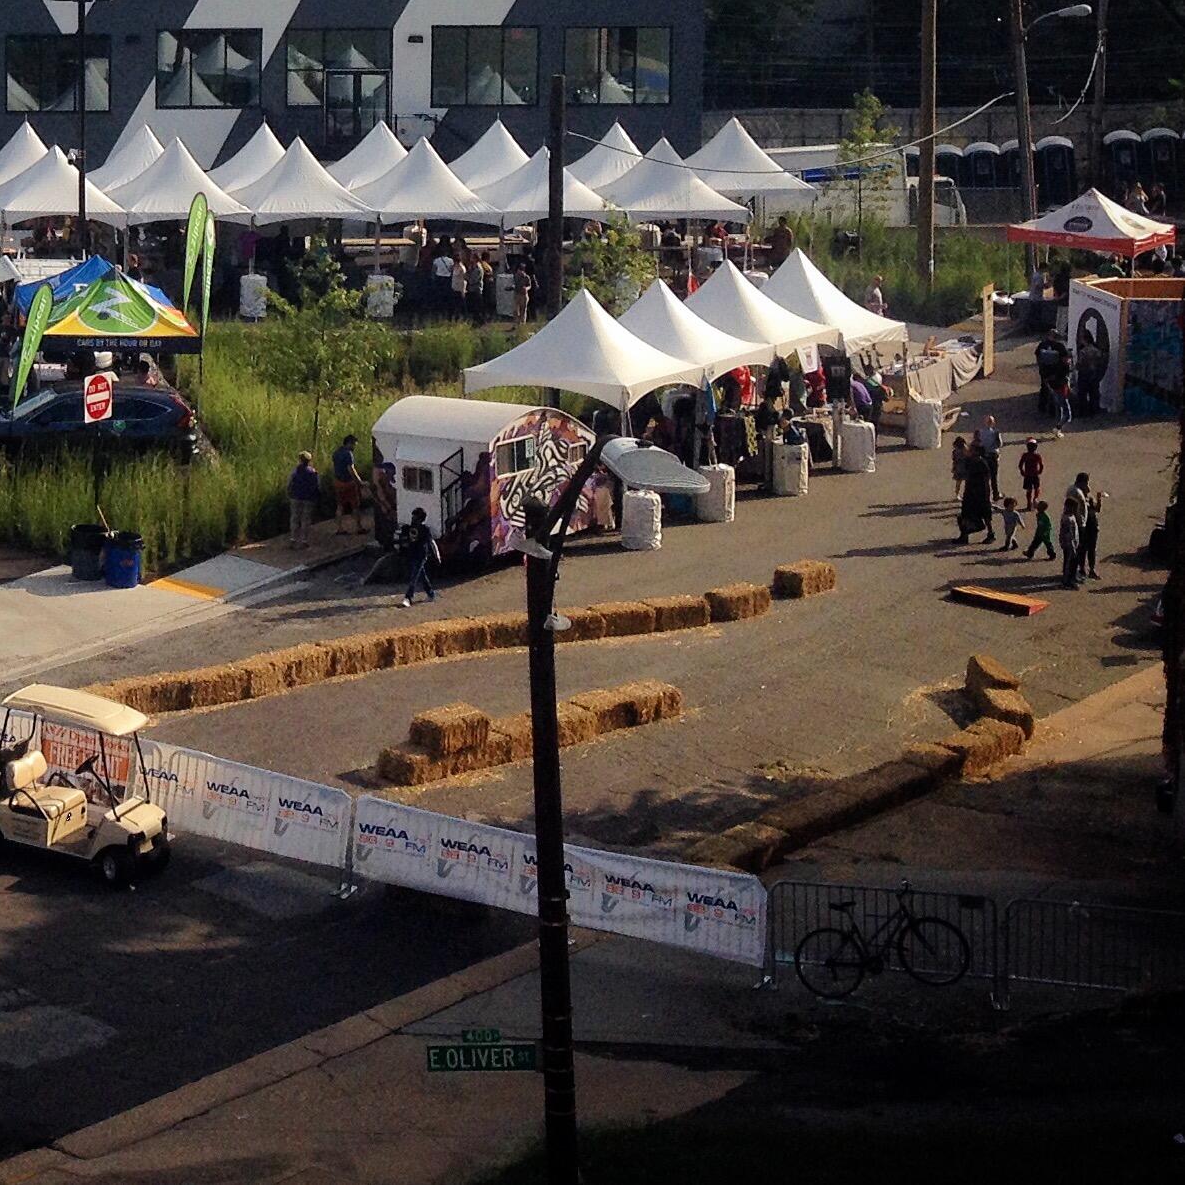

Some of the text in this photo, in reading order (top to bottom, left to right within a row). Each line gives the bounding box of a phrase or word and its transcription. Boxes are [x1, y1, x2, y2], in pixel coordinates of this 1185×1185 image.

[88, 381, 108, 394] DO NOT
[90, 401, 107, 413] ENTER
[206, 781, 250, 799] WEAA
[278, 797, 323, 816] WEAA
[359, 822, 409, 841] WEAA
[405, 841, 427, 854] FM
[440, 837, 491, 857] WEAA
[605, 874, 655, 894] WEAA
[687, 891, 738, 911] WEAA
[429, 1049, 440, 1069] E
[446, 1048, 515, 1069] OLIVER
